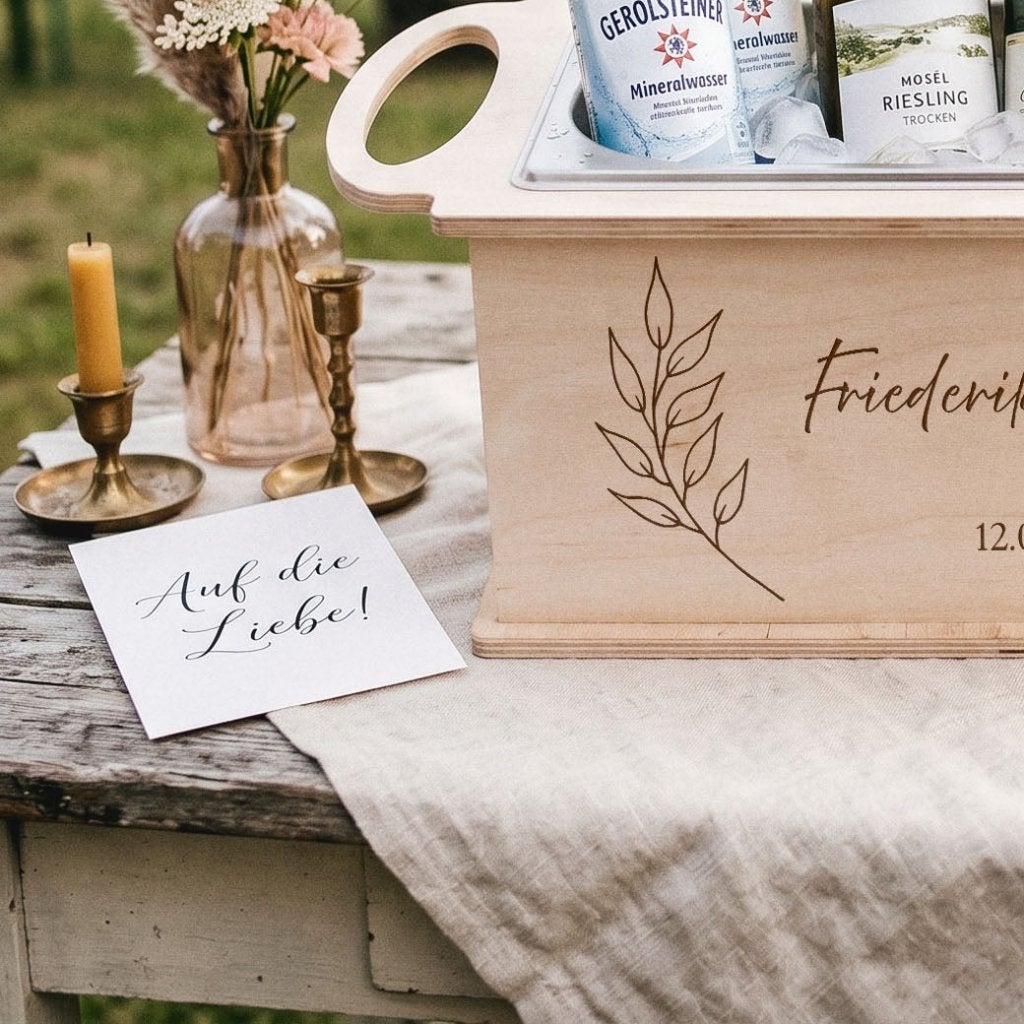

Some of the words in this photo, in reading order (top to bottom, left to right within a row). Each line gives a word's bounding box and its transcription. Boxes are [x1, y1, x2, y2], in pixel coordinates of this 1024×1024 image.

[630, 73, 728, 101] Mineralwasser
[883, 90, 968, 111] RIESLING
[903, 112, 957, 126] TROCKEN
[135, 559, 261, 620] Auf
[278, 544, 360, 582] die
[182, 586, 369, 661] Liebe!
